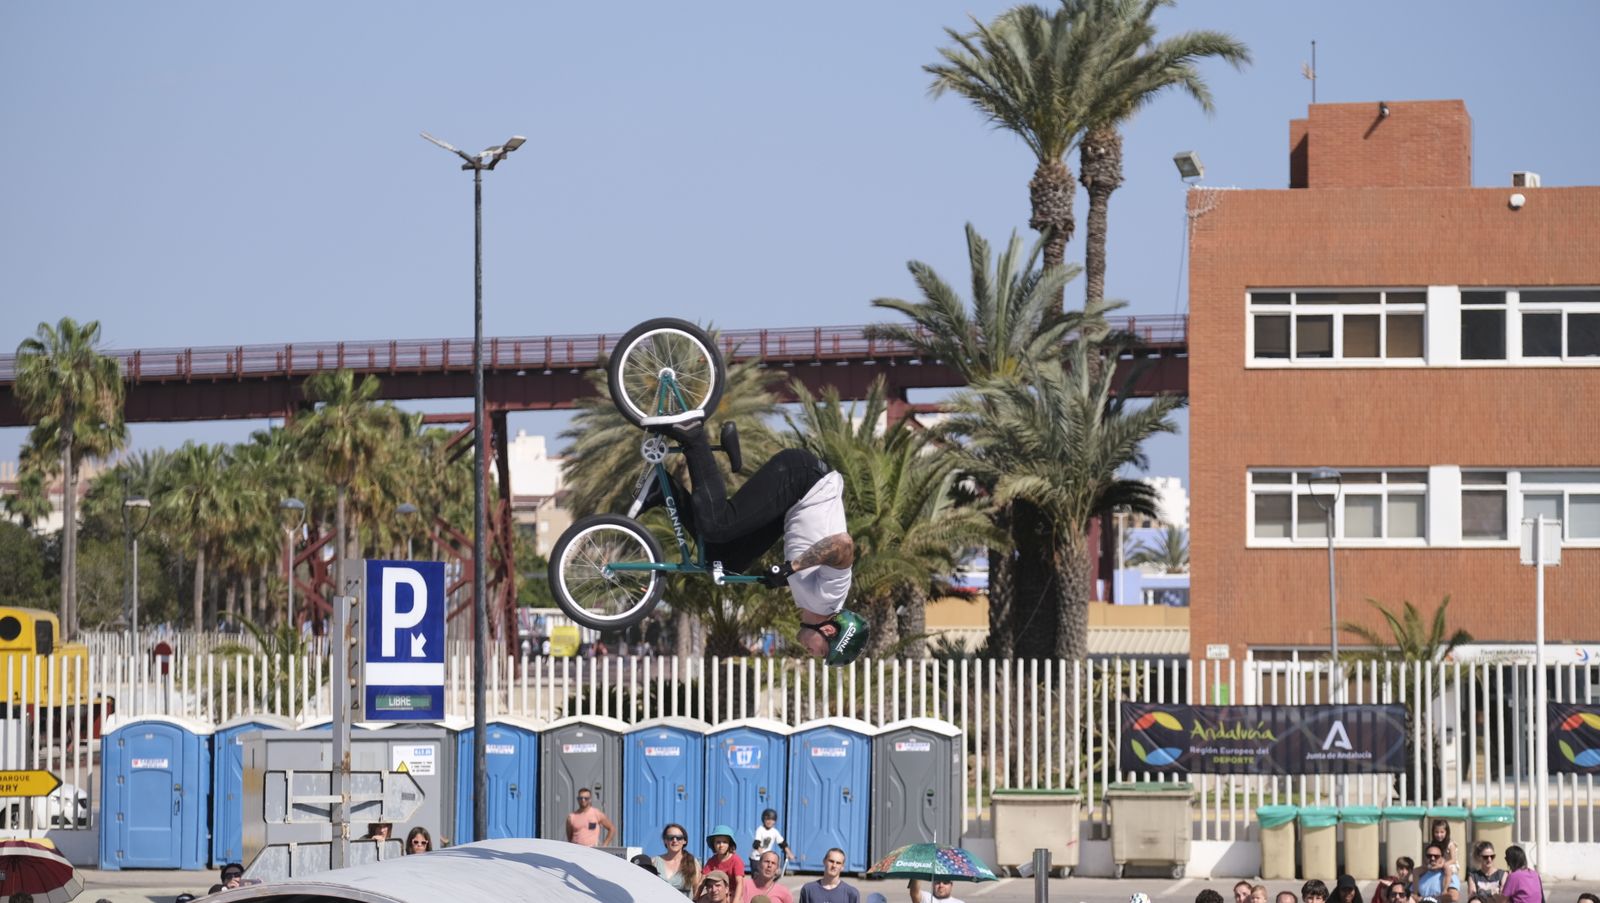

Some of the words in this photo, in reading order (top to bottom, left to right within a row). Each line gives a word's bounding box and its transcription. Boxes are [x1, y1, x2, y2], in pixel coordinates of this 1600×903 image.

[666, 496, 686, 547] CANNA
[381, 567, 428, 657] P
[836, 625, 857, 655] CANNA
[388, 695, 412, 706] LIBRE
[1190, 718, 1279, 742] Andalucía
[1189, 745, 1218, 755] Región
[1220, 746, 1255, 755] Europea
[1306, 752, 1327, 760] Junta
[1337, 751, 1373, 759] Andalucía
[1213, 756, 1255, 764] DEPORTE
[895, 859, 933, 869] Desigual
